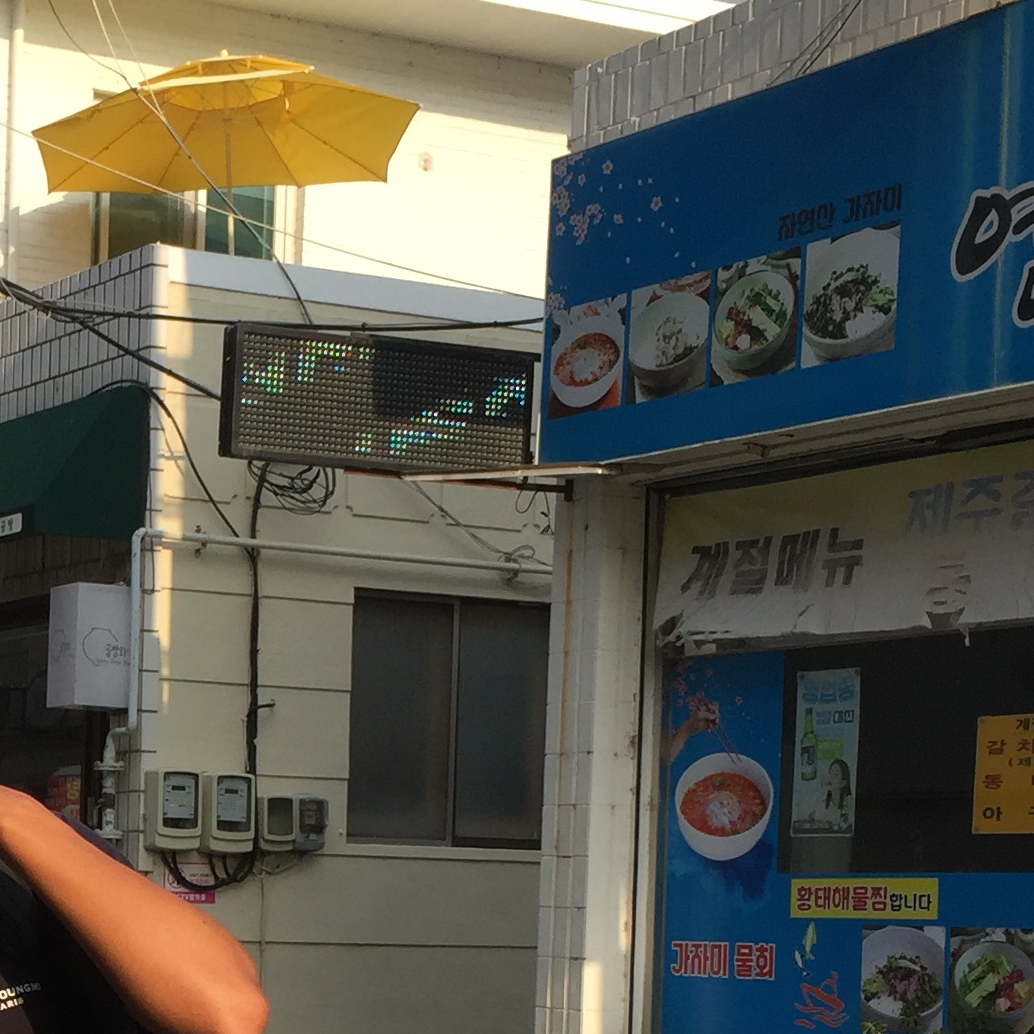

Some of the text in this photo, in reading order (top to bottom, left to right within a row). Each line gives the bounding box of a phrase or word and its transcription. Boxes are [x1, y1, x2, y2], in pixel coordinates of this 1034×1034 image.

[842, 183, 903, 224] 가자미
[680, 527, 864, 600] 계절메뉴
[1016, 718, 1034, 731] 계
[795, 885, 933, 912] 황태해물찜합니다
[670, 940, 776, 981] 가자미 물회
